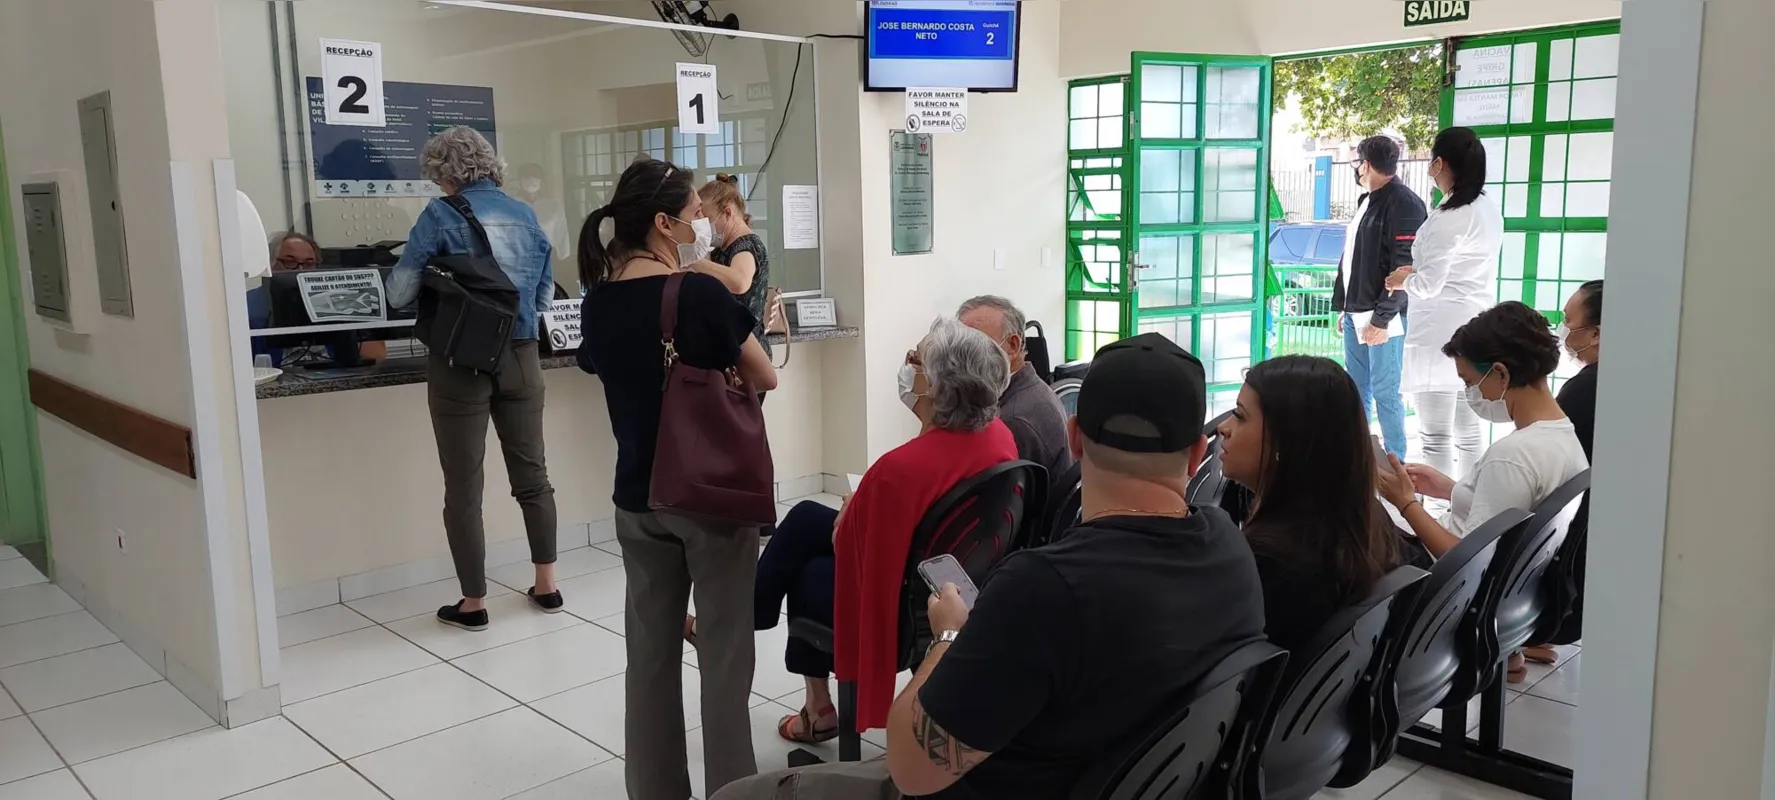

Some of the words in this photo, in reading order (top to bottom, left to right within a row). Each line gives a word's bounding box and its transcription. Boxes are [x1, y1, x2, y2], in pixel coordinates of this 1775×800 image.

[877, 22, 899, 30] JOSE
[901, 22, 946, 31] BERNARDO
[948, 23, 975, 31] COSTA
[915, 32, 938, 40] NETO
[986, 32, 994, 45] 2
[326, 46, 373, 57] RECEPÇÃO
[337, 75, 370, 114] 2
[689, 93, 704, 124] 1
[553, 313, 582, 321] SILÊNC
